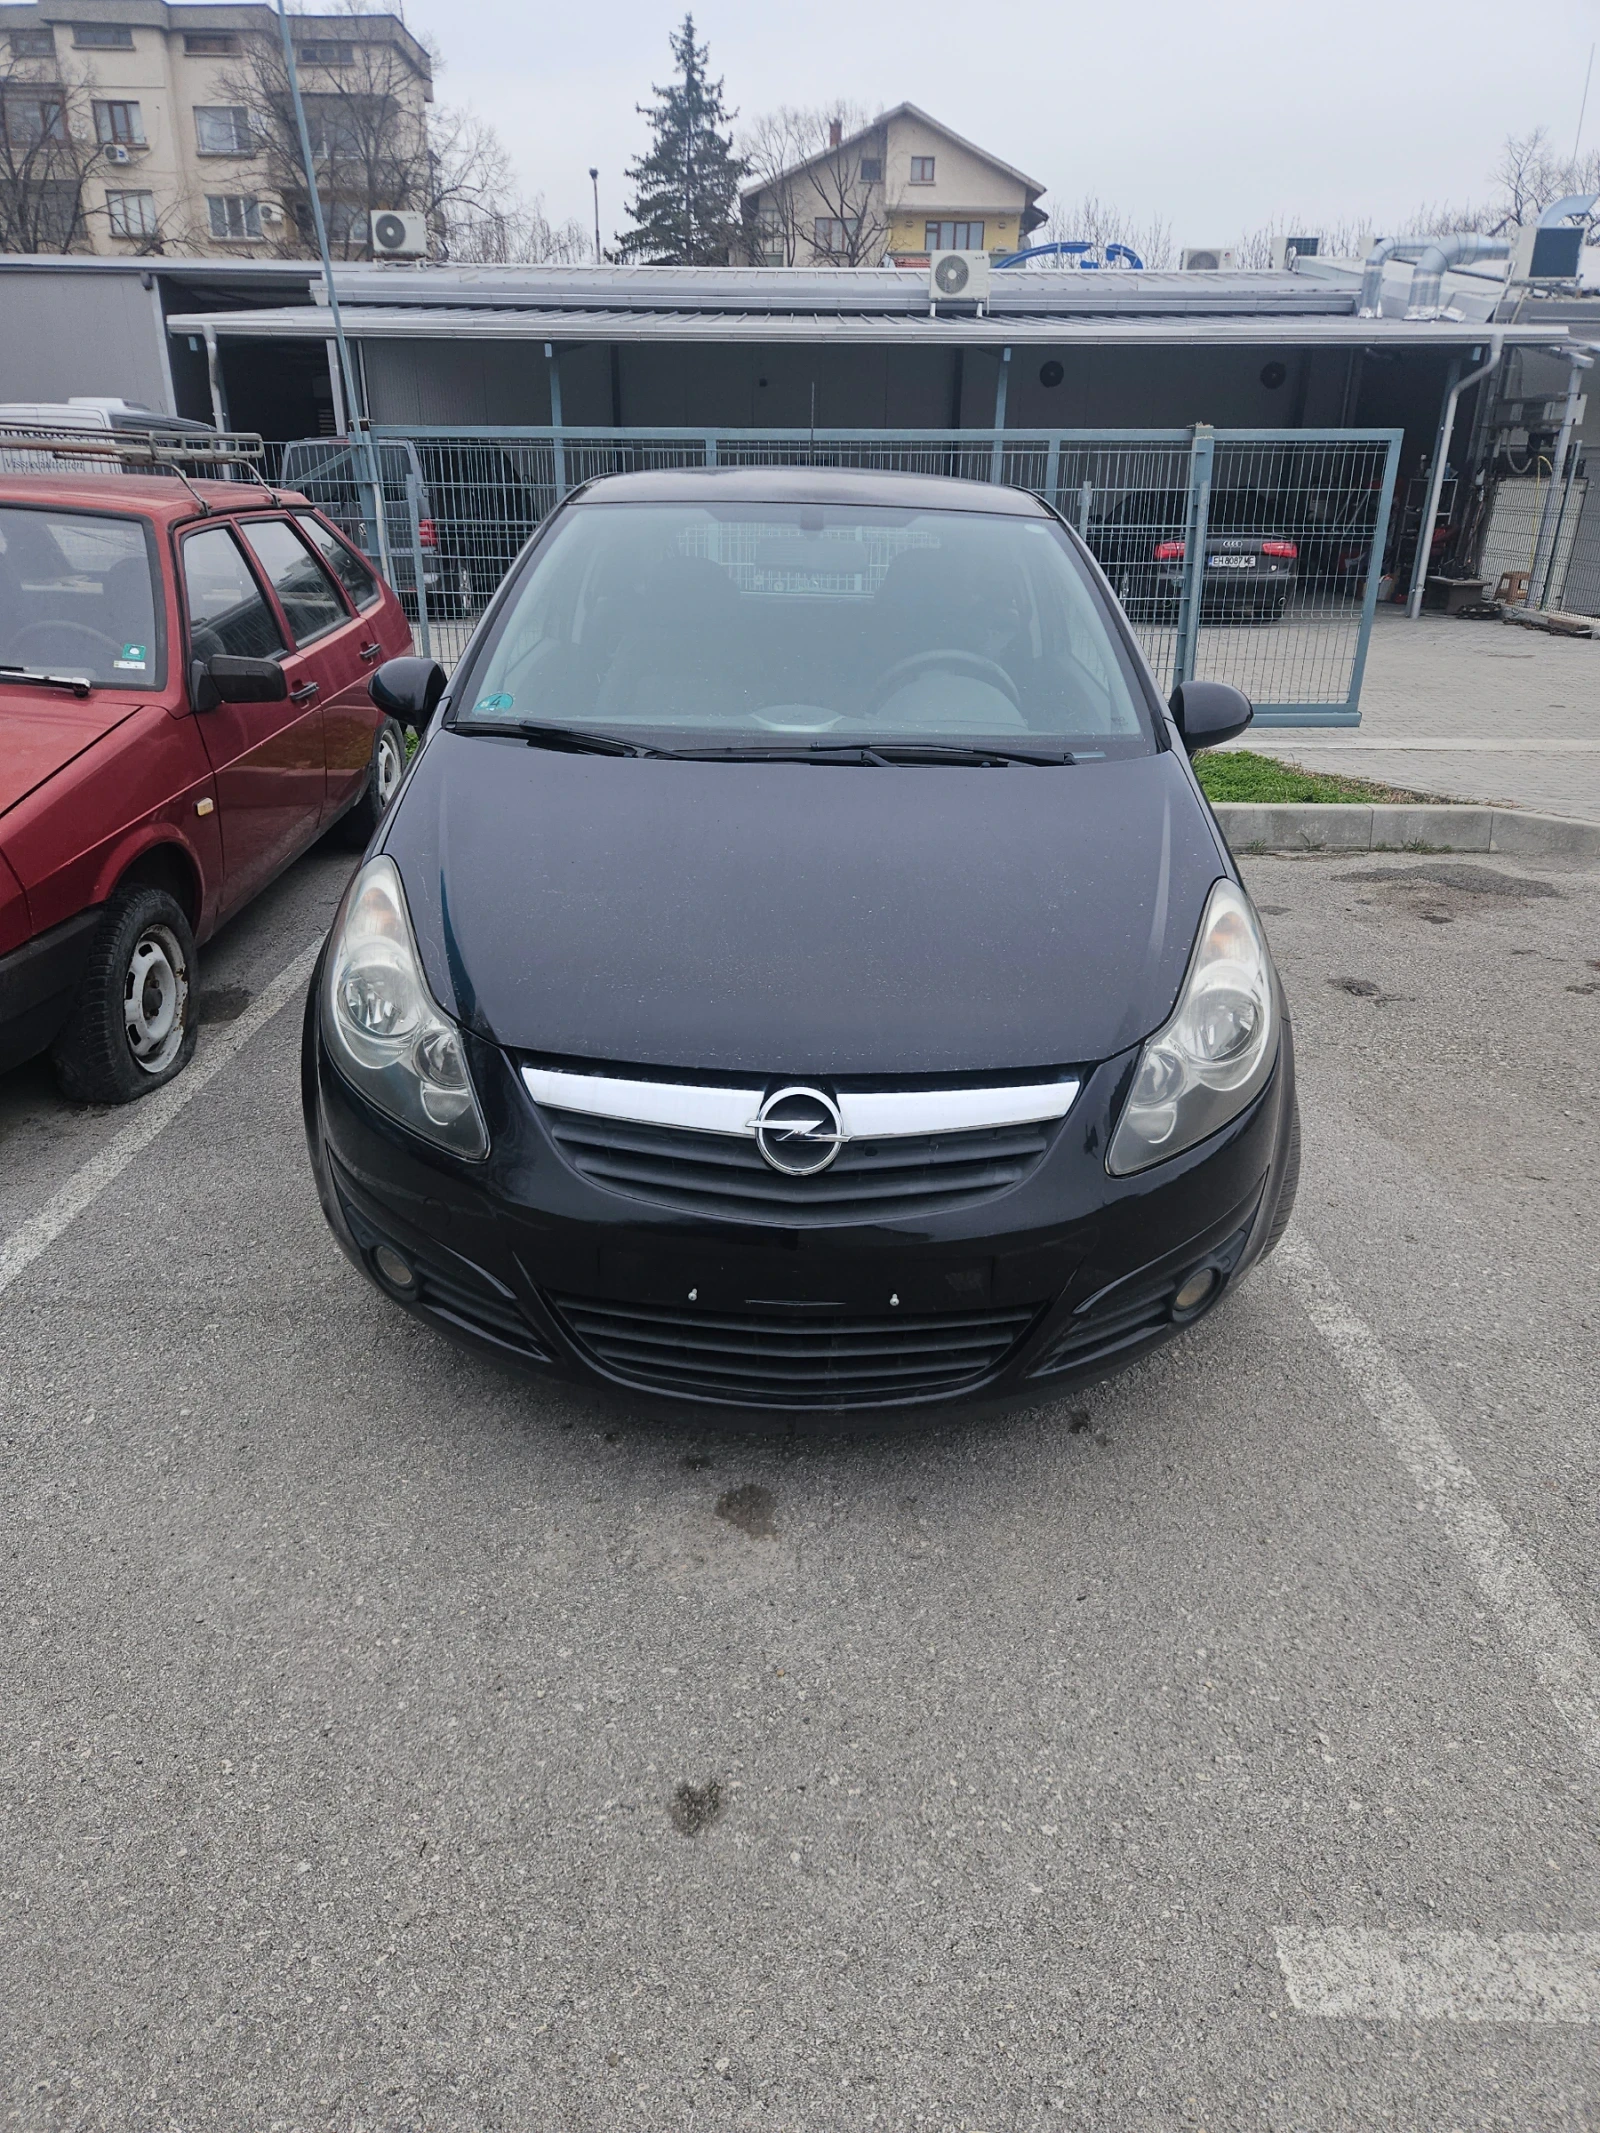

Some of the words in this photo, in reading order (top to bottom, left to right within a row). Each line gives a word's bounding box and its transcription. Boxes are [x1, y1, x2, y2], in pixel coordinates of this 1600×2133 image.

[1213, 556, 1224, 565] EH
[1225, 556, 1243, 565] 8087
[490, 695, 502, 707] 4
